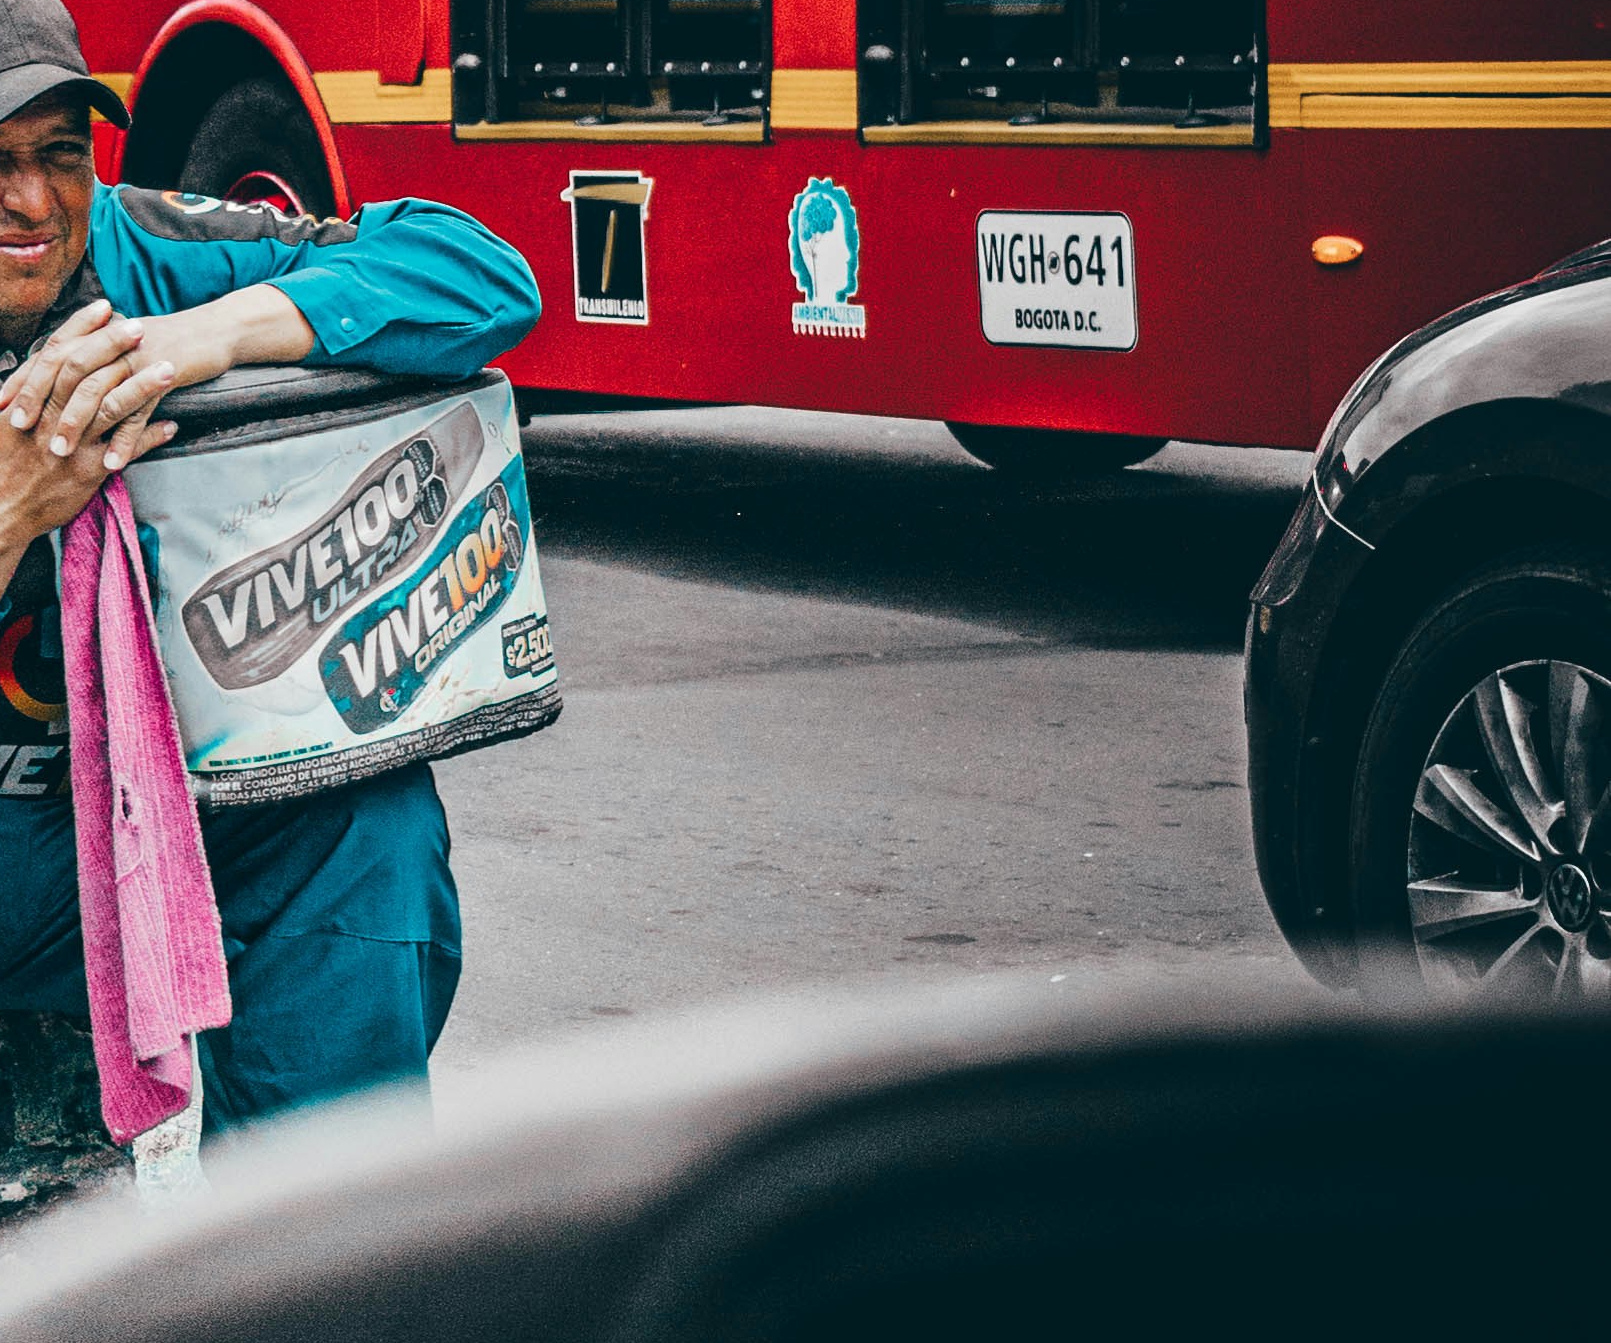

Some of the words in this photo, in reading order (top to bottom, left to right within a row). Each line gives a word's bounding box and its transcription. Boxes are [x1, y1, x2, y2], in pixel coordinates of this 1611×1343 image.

[981, 233, 1046, 285] WGH
[1063, 234, 1125, 287] 641
[578, 296, 645, 318] TRANSMILENIO
[1014, 308, 1070, 331] BOGOTA
[1074, 310, 1102, 333] D.C.
[312, 518, 419, 624] ULTRA
[414, 573, 502, 673] ORIGINAL
[210, 781, 230, 792] POR
[231, 780, 243, 791] EL
[243, 773, 297, 790] CONSUMO
[297, 770, 310, 781] DE
[311, 762, 348, 779] BEBIDAS
[277, 758, 319, 774] ELEVADO
[210, 790, 250, 802] BEBIDAS
